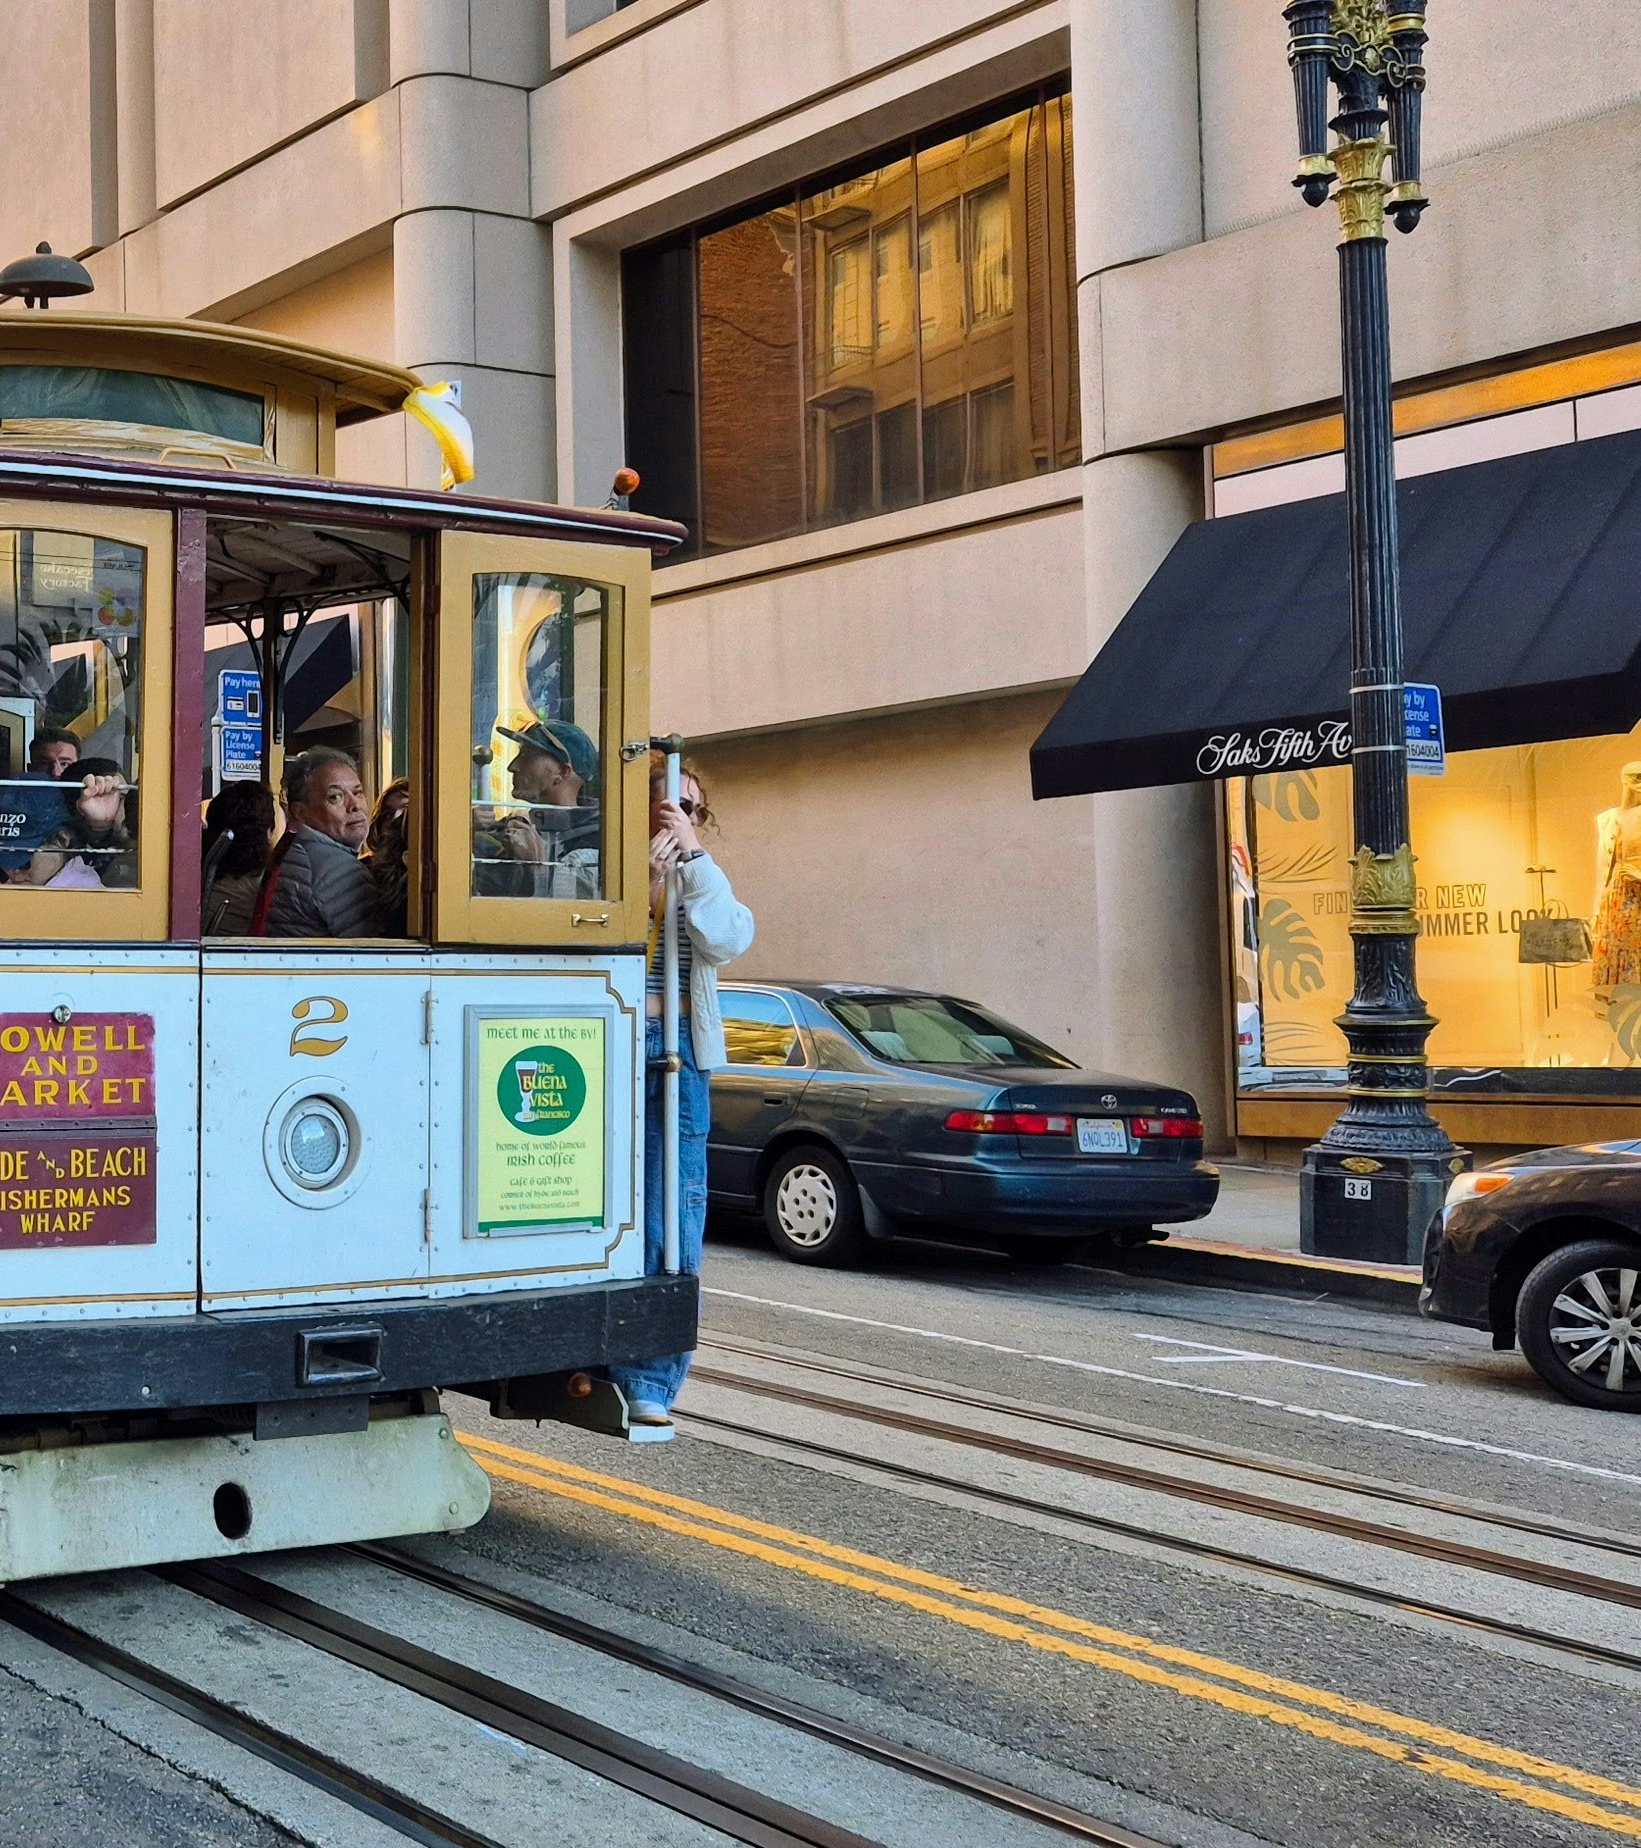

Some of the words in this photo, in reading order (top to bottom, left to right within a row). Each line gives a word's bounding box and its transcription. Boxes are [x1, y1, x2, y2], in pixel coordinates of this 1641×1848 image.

[225, 677, 240, 689] Pay
[1413, 690, 1425, 709] by
[225, 731, 240, 742] Pay
[243, 731, 253, 742] by
[226, 740, 255, 750] License
[226, 750, 246, 759] Plate
[1196, 732, 1261, 775] Saks
[1253, 728, 1316, 769] Fifth
[1437, 883, 1487, 909] NEW
[290, 996, 348, 1056] 2
[20, 1055, 99, 1077] AND
[37, 1151, 65, 1178] AND
[70, 1147, 146, 1177] BEACH
[1347, 1182, 1369, 1197] 38
[20, 1211, 96, 1234] WHARF
